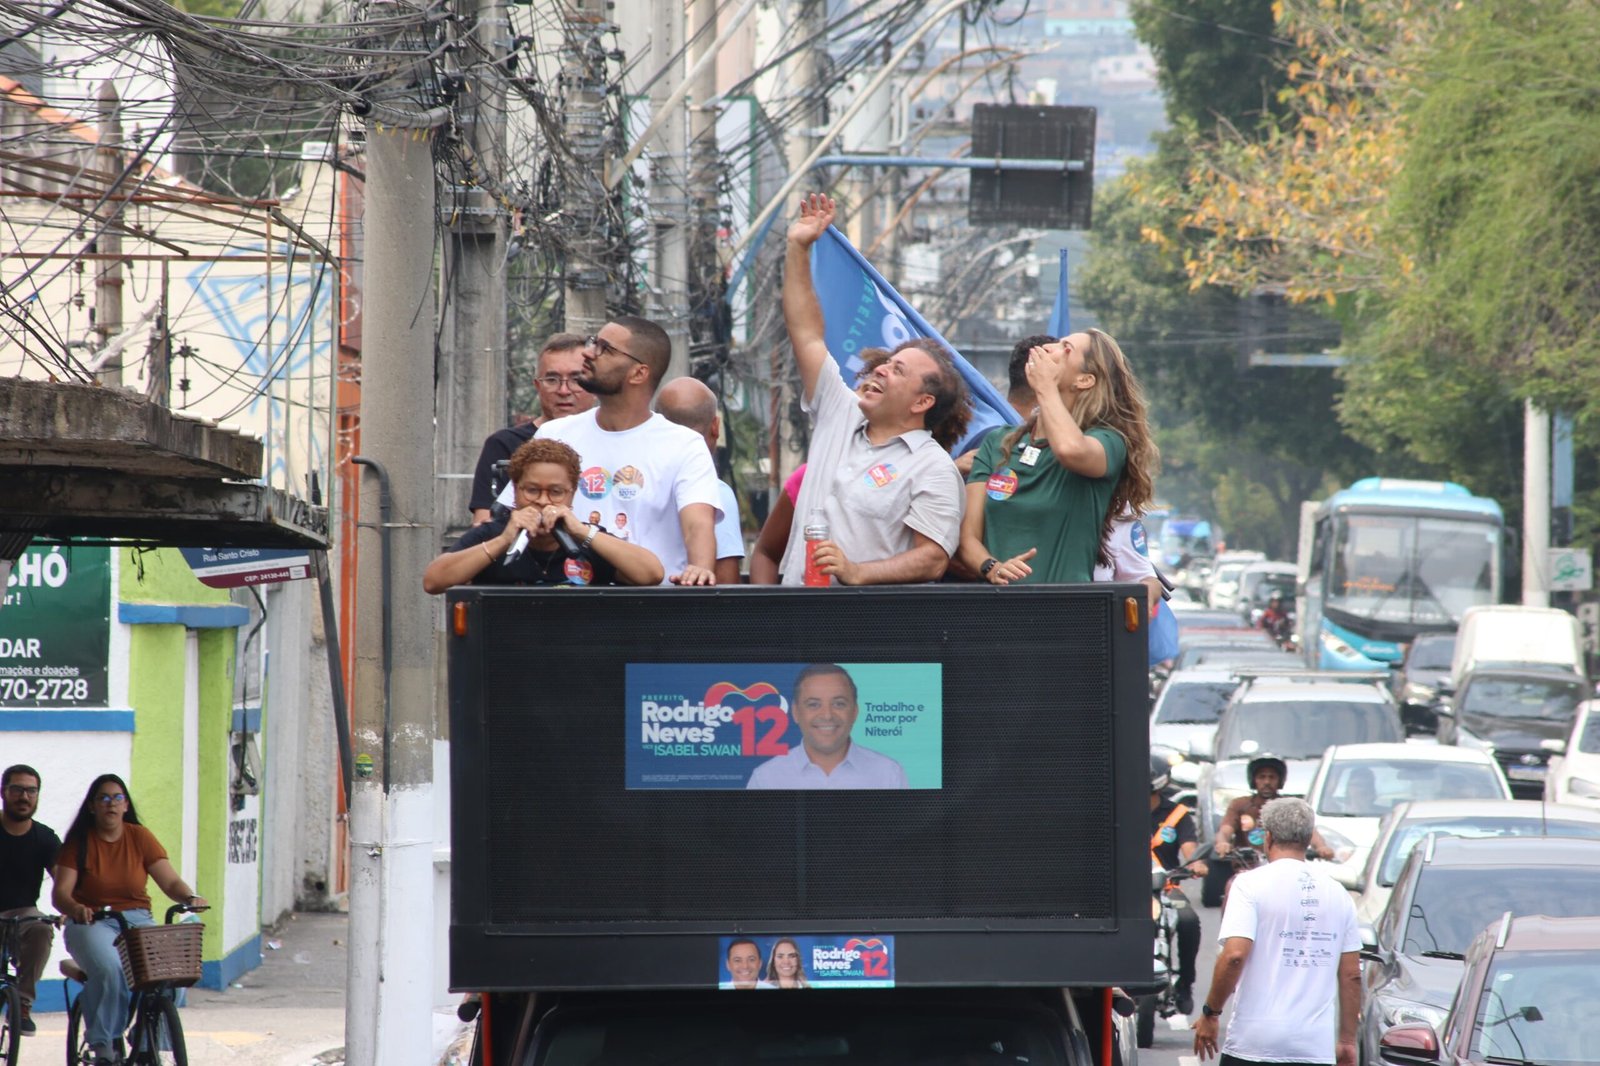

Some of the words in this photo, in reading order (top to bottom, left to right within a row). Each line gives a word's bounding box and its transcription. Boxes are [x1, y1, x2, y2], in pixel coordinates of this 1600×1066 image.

[588, 474, 606, 493] 12
[203, 553, 217, 562] Rua
[218, 551, 238, 560] Santo
[240, 549, 260, 557] Cristo
[244, 574, 259, 582] CEP:
[34, 667, 40, 675] e
[42, 665, 79, 677] doações
[0, 678, 88, 700] 70-2728
[642, 700, 735, 727] Rodrigo
[865, 702, 915, 712] Trabalho
[917, 704, 925, 712] e
[865, 713, 896, 723] Amor
[898, 715, 917, 725] por
[642, 722, 716, 743] Neves
[731, 705, 789, 757] 12
[865, 726, 903, 736] Niterói
[654, 744, 698, 756] ISABEL
[700, 744, 741, 756] SWAN
[813, 947, 861, 962] Rodrigo
[813, 959, 851, 970] Neves
[860, 950, 889, 977] 12
